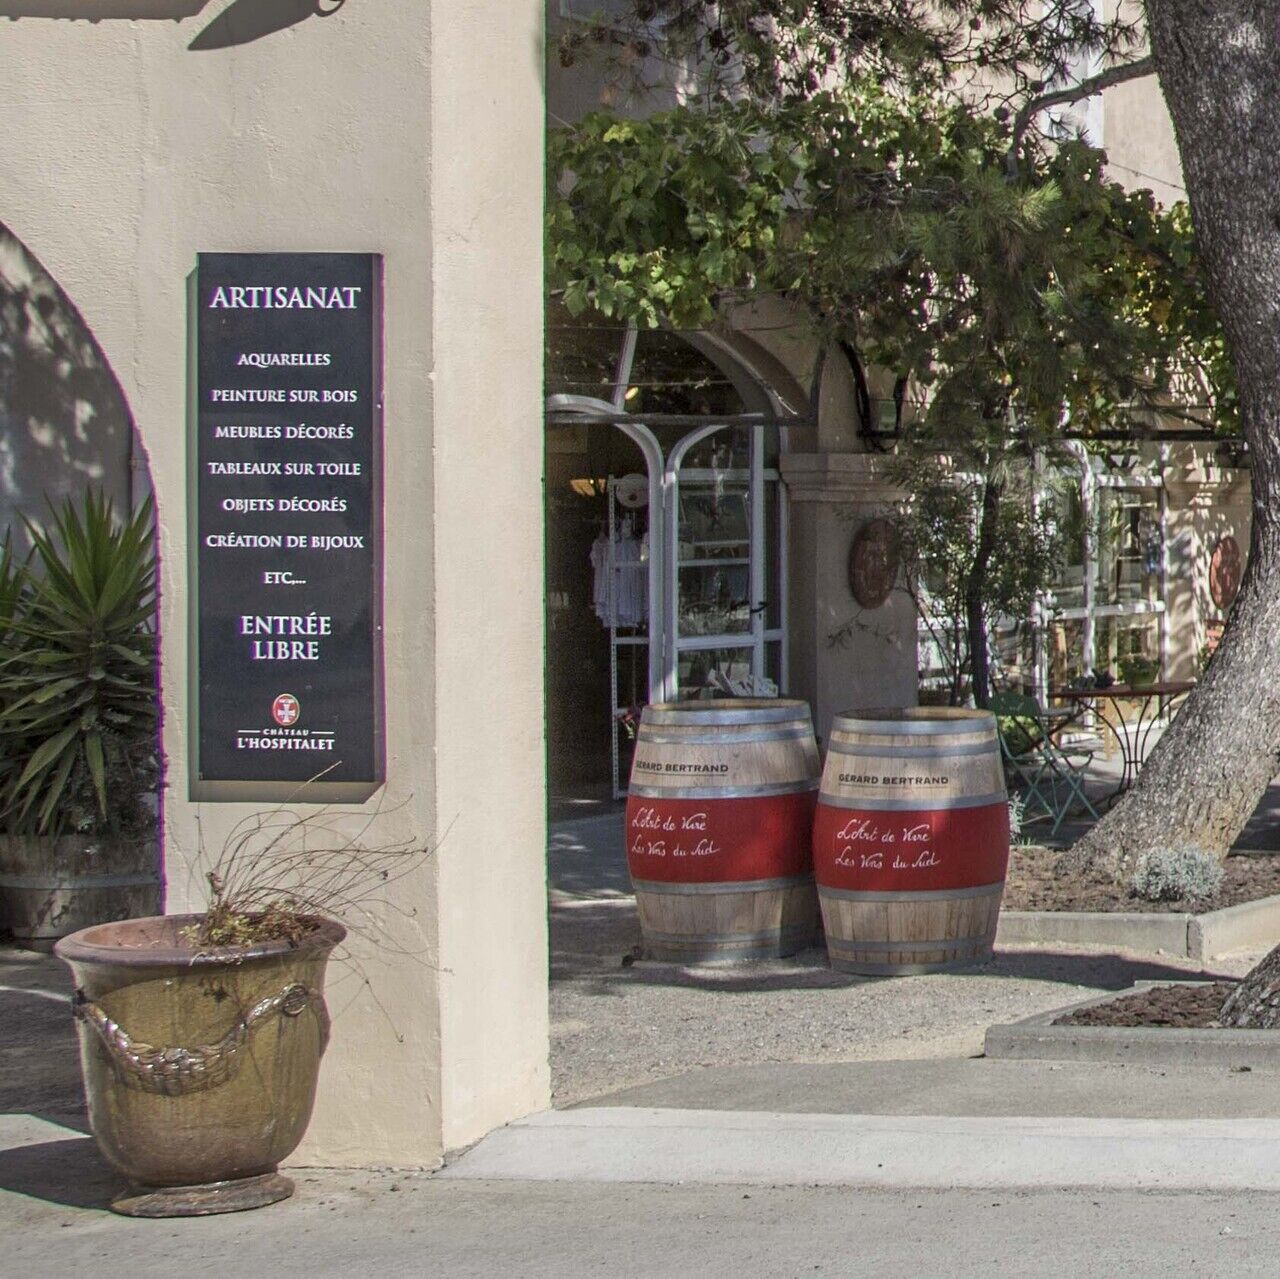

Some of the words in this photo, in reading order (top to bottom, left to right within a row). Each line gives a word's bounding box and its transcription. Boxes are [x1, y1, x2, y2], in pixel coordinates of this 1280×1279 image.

[209, 286, 362, 309] ARTISANAT
[237, 353, 331, 368] AQUARELLES
[211, 389, 286, 402] PEINTURE
[289, 389, 320, 402] SUR
[322, 390, 358, 403] BOIS
[215, 426, 281, 438] MEUBLES
[285, 423, 354, 439] DÉCORÉS
[208, 462, 282, 475] TABLEAUX
[284, 463, 315, 475] SUR
[317, 463, 361, 475] TOILE
[221, 499, 274, 513] OBJETS
[278, 496, 347, 512] DÉCORÉS
[206, 532, 282, 548] CRÉATION
[286, 535, 307, 548] DE
[311, 536, 364, 551] BIJOUX
[240, 612, 332, 635] ENTRÉE
[253, 640, 319, 660] LIBRE
[237, 737, 335, 750] L'HOSPITALET
[665, 763, 729, 772] BERTRAND
[882, 776, 949, 785] BERTRAND
[662, 815, 676, 831] de
[881, 829, 896, 843] de
[673, 843, 688, 856] du
[835, 846, 855, 867] Les
[892, 854, 909, 869] du
